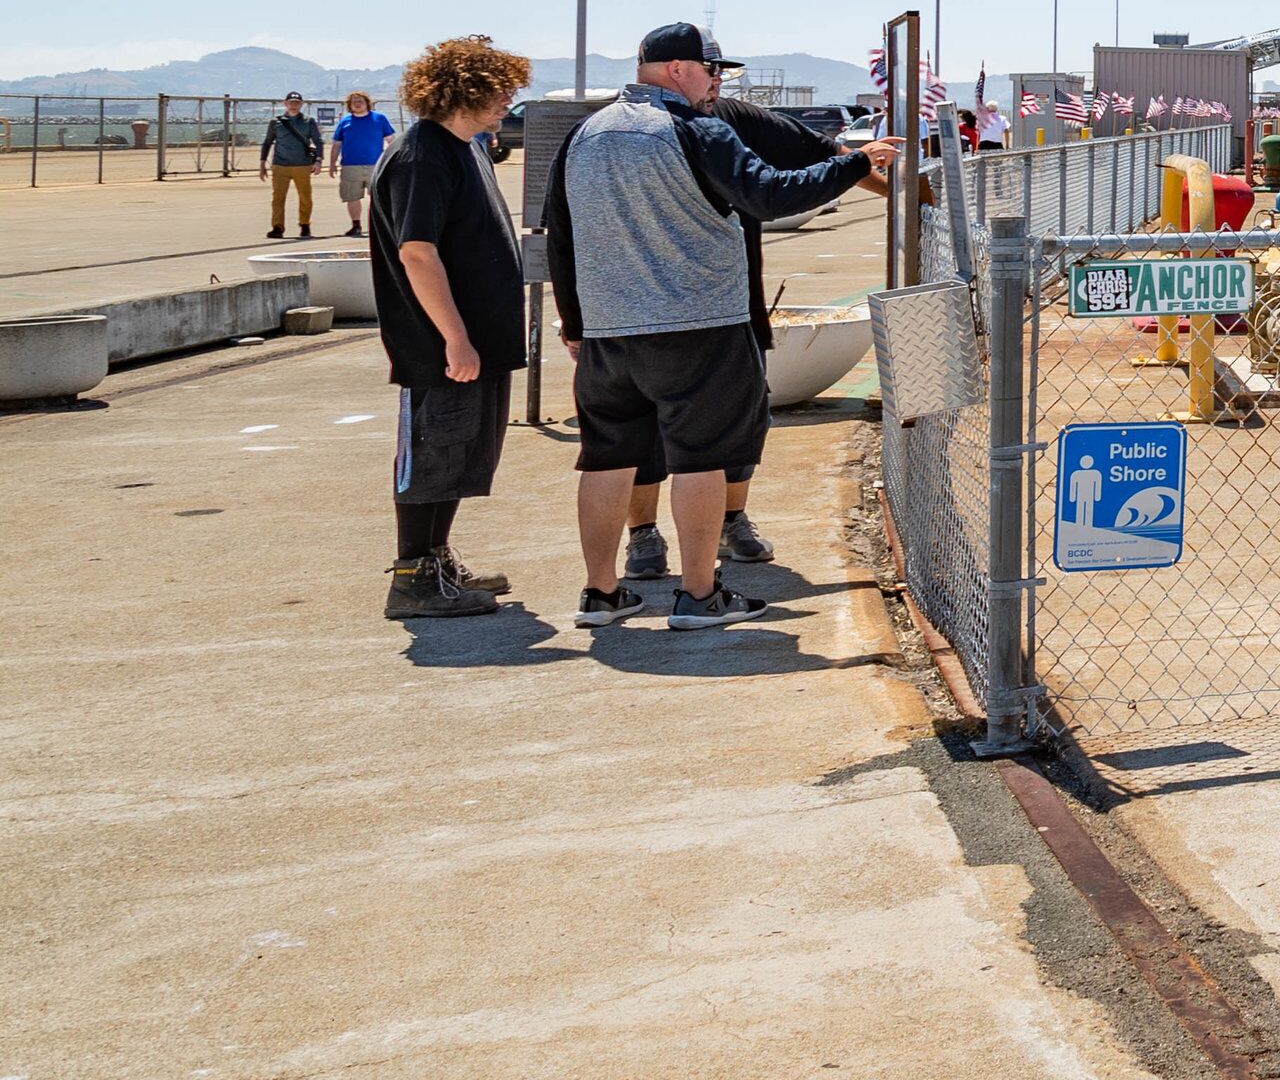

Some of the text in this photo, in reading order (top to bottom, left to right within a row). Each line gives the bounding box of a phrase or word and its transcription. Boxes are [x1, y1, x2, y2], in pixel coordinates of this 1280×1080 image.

[1087, 269, 1126, 282] DIAR
[1135, 263, 1246, 312] ANCHOR
[1088, 292, 1128, 311] 594
[1167, 300, 1239, 311] FENCE
[1110, 442, 1168, 459] Public
[1110, 465, 1167, 482] Shore
[1067, 549, 1094, 558] BCDC
